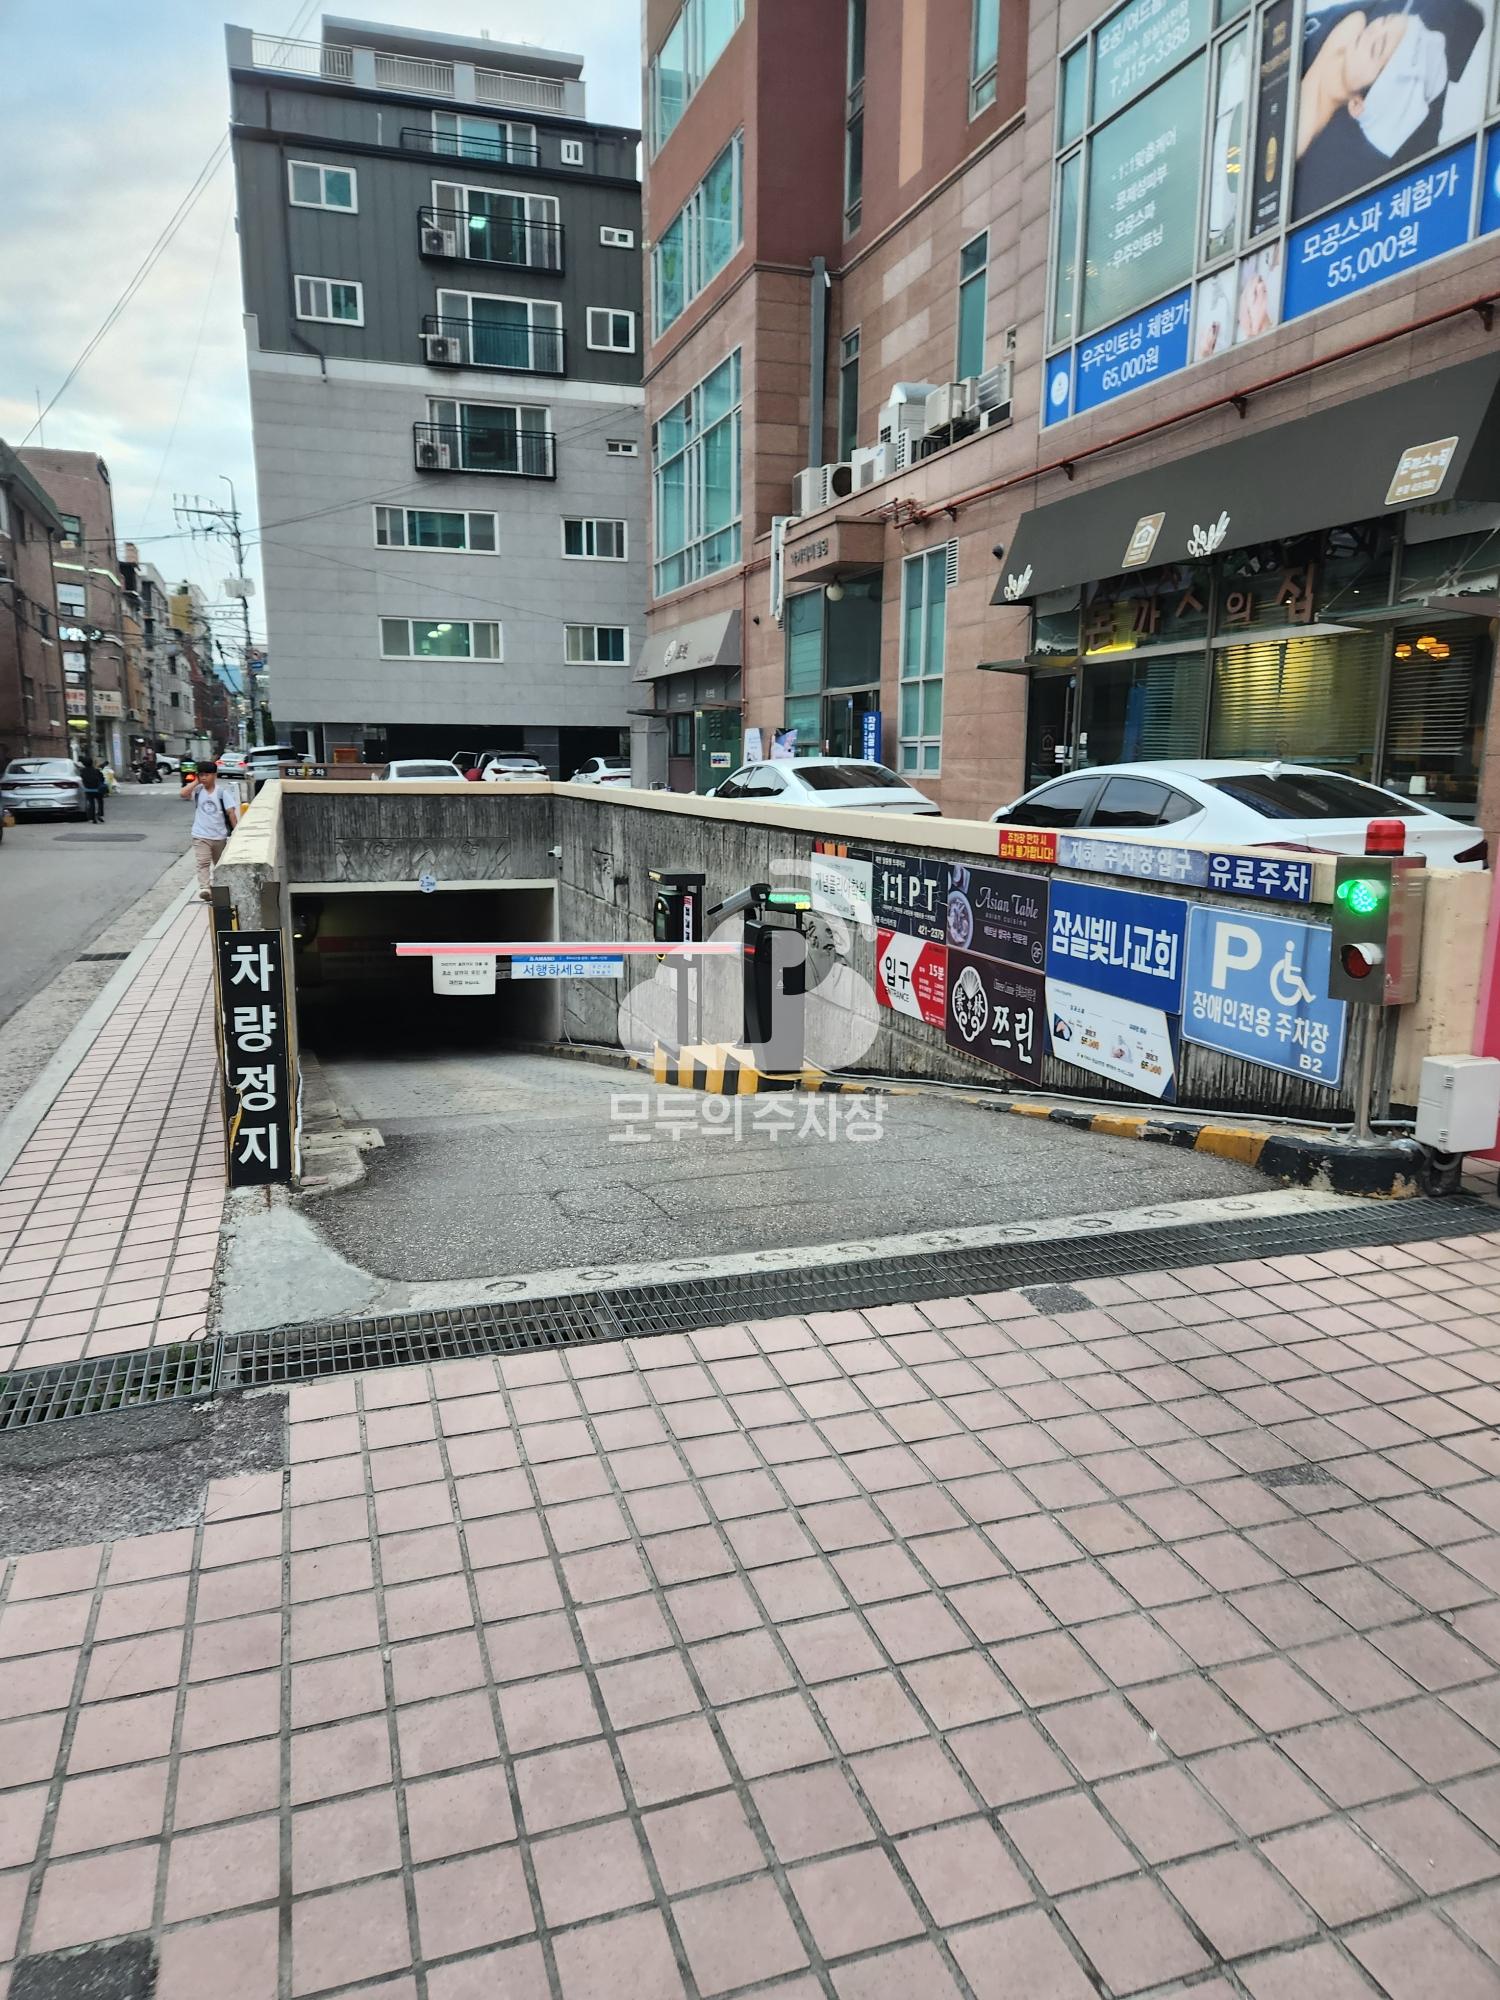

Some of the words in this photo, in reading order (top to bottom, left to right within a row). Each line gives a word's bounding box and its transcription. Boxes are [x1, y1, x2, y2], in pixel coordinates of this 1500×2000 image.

[1113, 200, 1156, 240] 모공스파
[1301, 202, 1382, 263] 모공스파
[1388, 163, 1459, 220] 체험가
[1327, 221, 1419, 288] 55,000원
[1081, 322, 1143, 373] 우주인토닝
[1147, 299, 1191, 338] 체험가
[1102, 345, 1159, 390] 65,000원
[1007, 832, 1025, 844] 주차장
[1071, 840, 1096, 864] 지하
[1104, 847, 1193, 881] 주차장입구
[882, 871, 902, 905] 1:1
[1211, 856, 1308, 901] 유료주차
[975, 886, 1009, 912] Asian
[1011, 894, 1038, 919] Table
[1052, 909, 1178, 980] 잠실빛나교회
[1210, 921, 1262, 990] P
[523, 963, 585, 977] 서행하세요
[885, 956, 910, 989] 입구
[929, 963, 944, 981] 15분
[990, 1006, 1034, 1064] 쯔린
[1193, 991, 1270, 1037] 장애인전용
[1275, 1012, 1329, 1054] 주차장
[230, 943, 277, 1170] 차량정지
[1299, 1054, 1322, 1074] B2
